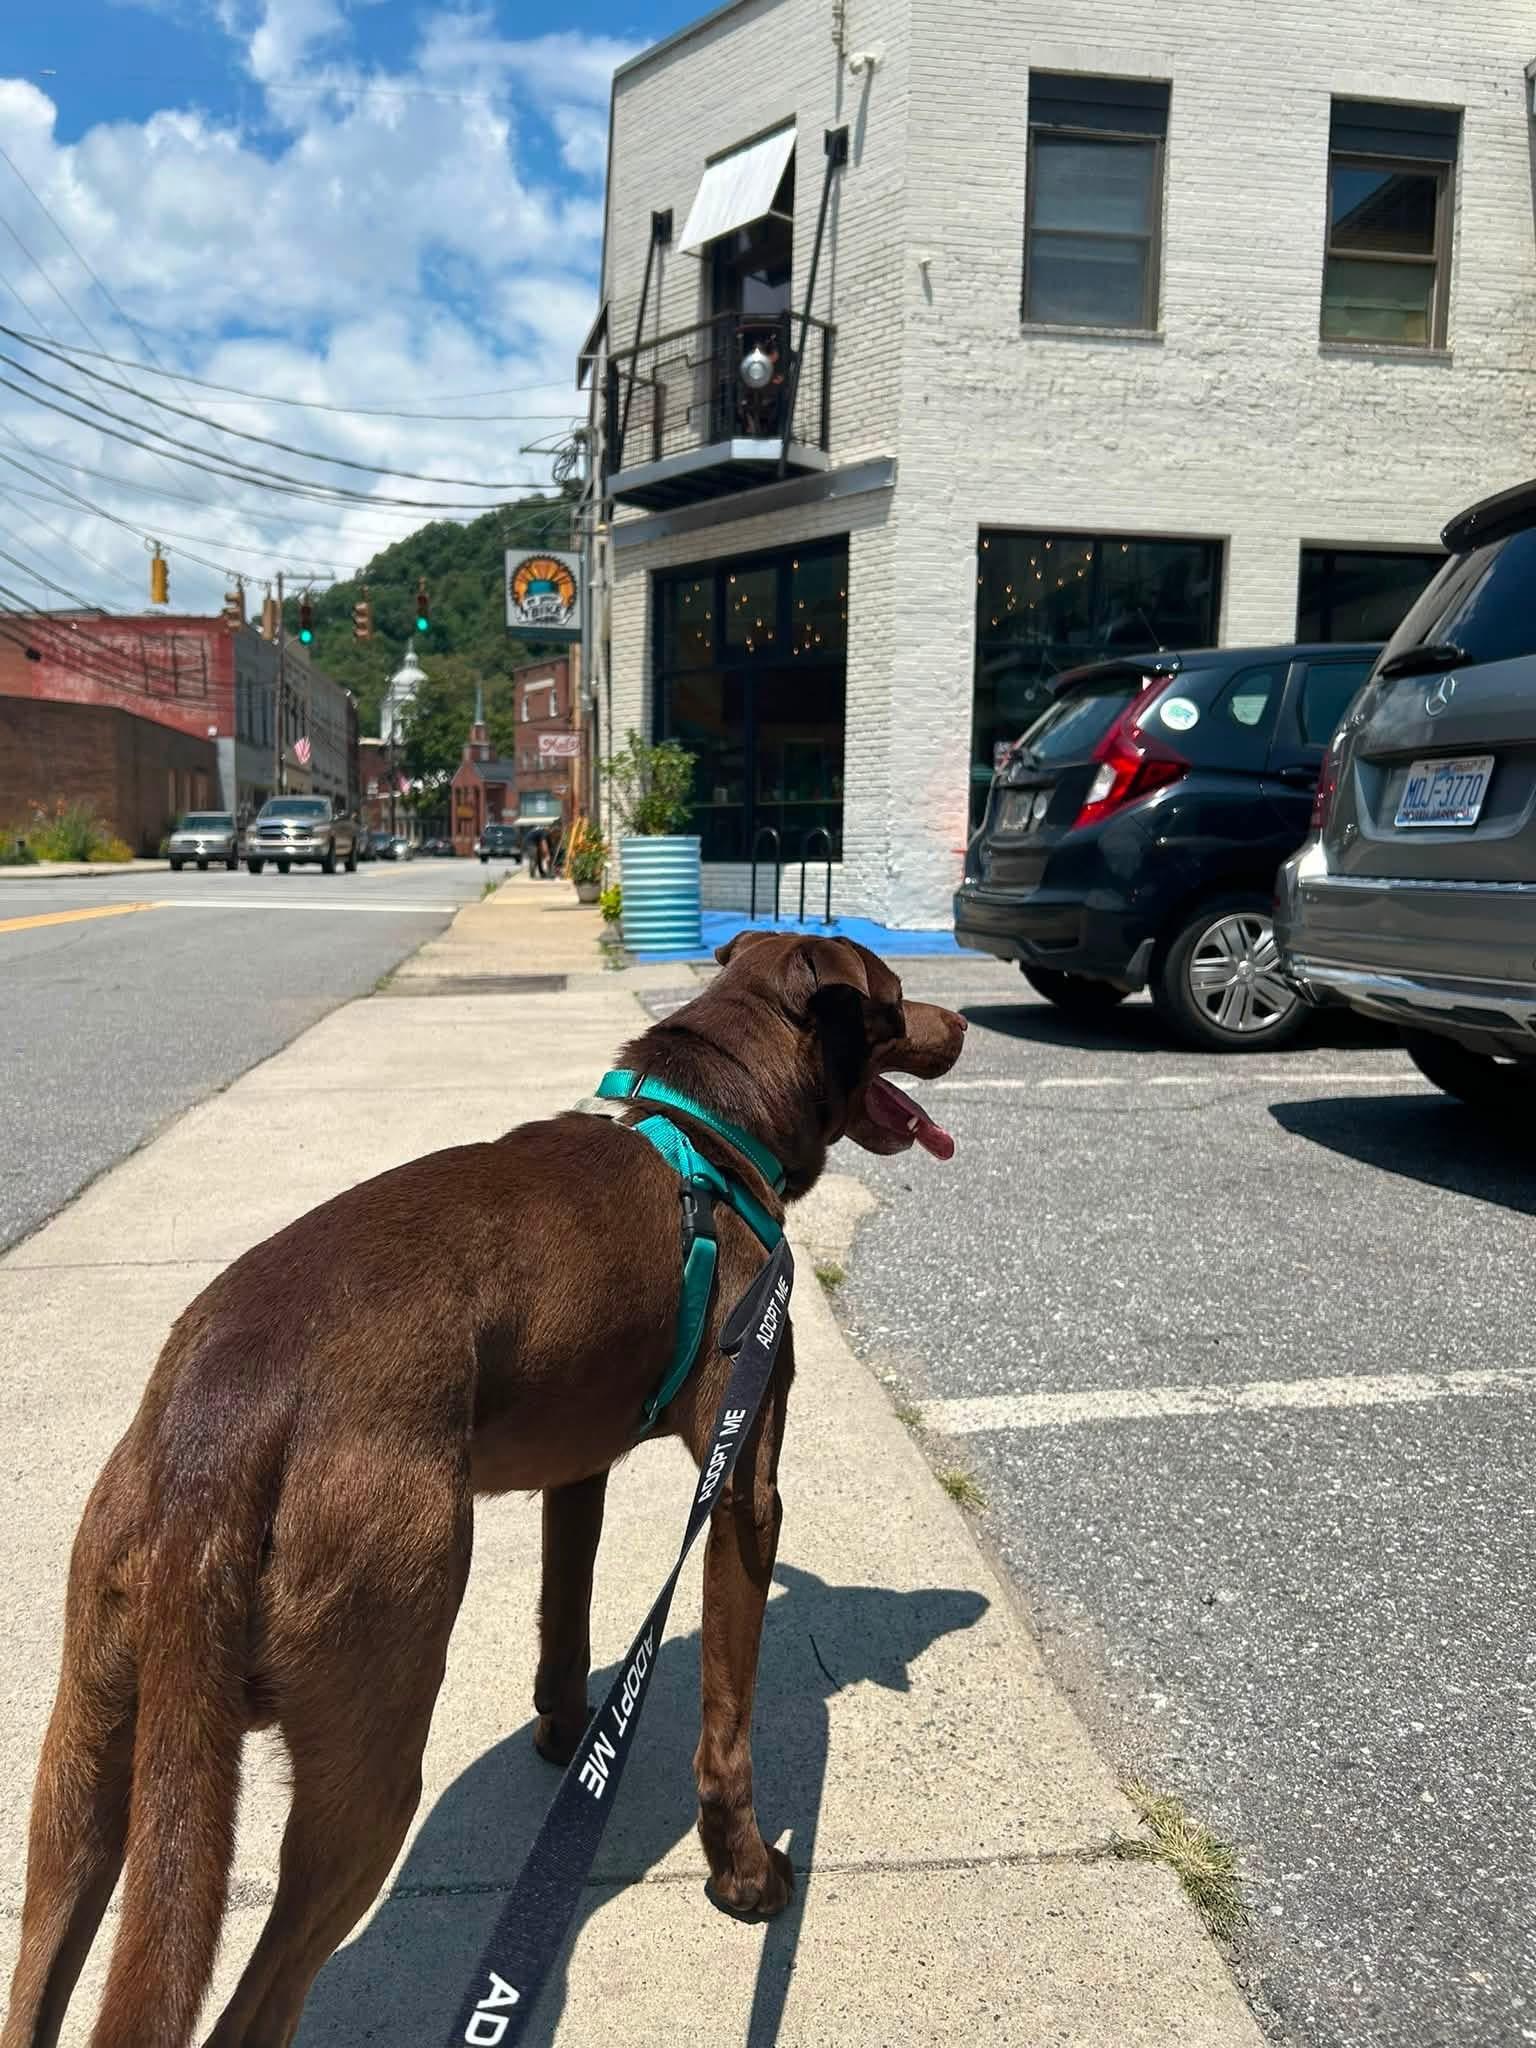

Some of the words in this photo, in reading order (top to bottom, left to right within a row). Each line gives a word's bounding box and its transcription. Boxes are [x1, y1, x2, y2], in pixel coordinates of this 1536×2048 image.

[756, 1298, 782, 1351] ADOPT
[775, 1275, 789, 1304] ME
[699, 1442, 733, 1503] ADOPT
[719, 1409, 747, 1435] ME
[611, 1625, 653, 1738] ADOPT
[579, 1731, 616, 1800] ME
[464, 1971, 521, 2047] AD
